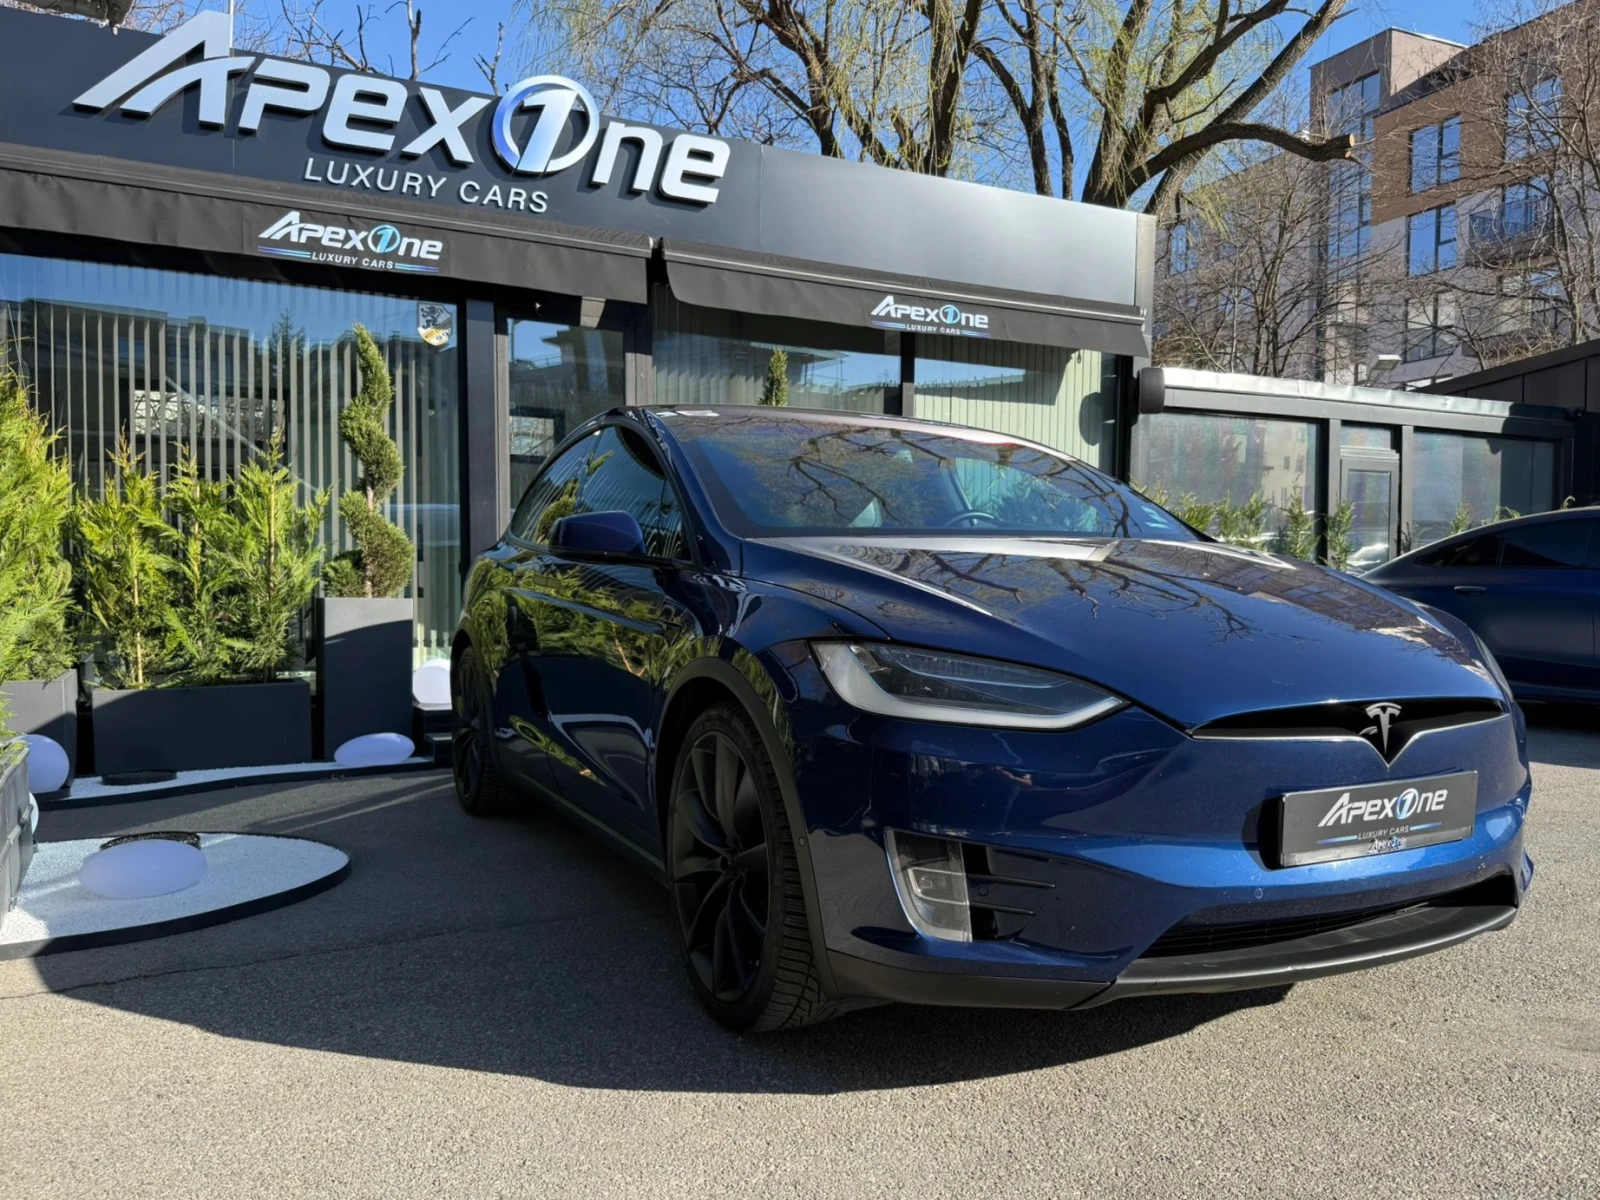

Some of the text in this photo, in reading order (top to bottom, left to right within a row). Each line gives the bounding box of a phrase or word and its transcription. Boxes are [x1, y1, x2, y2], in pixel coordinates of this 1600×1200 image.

[304, 157, 549, 214] LUXURY CARS
[311, 251, 394, 269] LUXURY CARS
[906, 323, 961, 335] LUXURY CARS
[1358, 825, 1410, 840] LUXURY CARS
